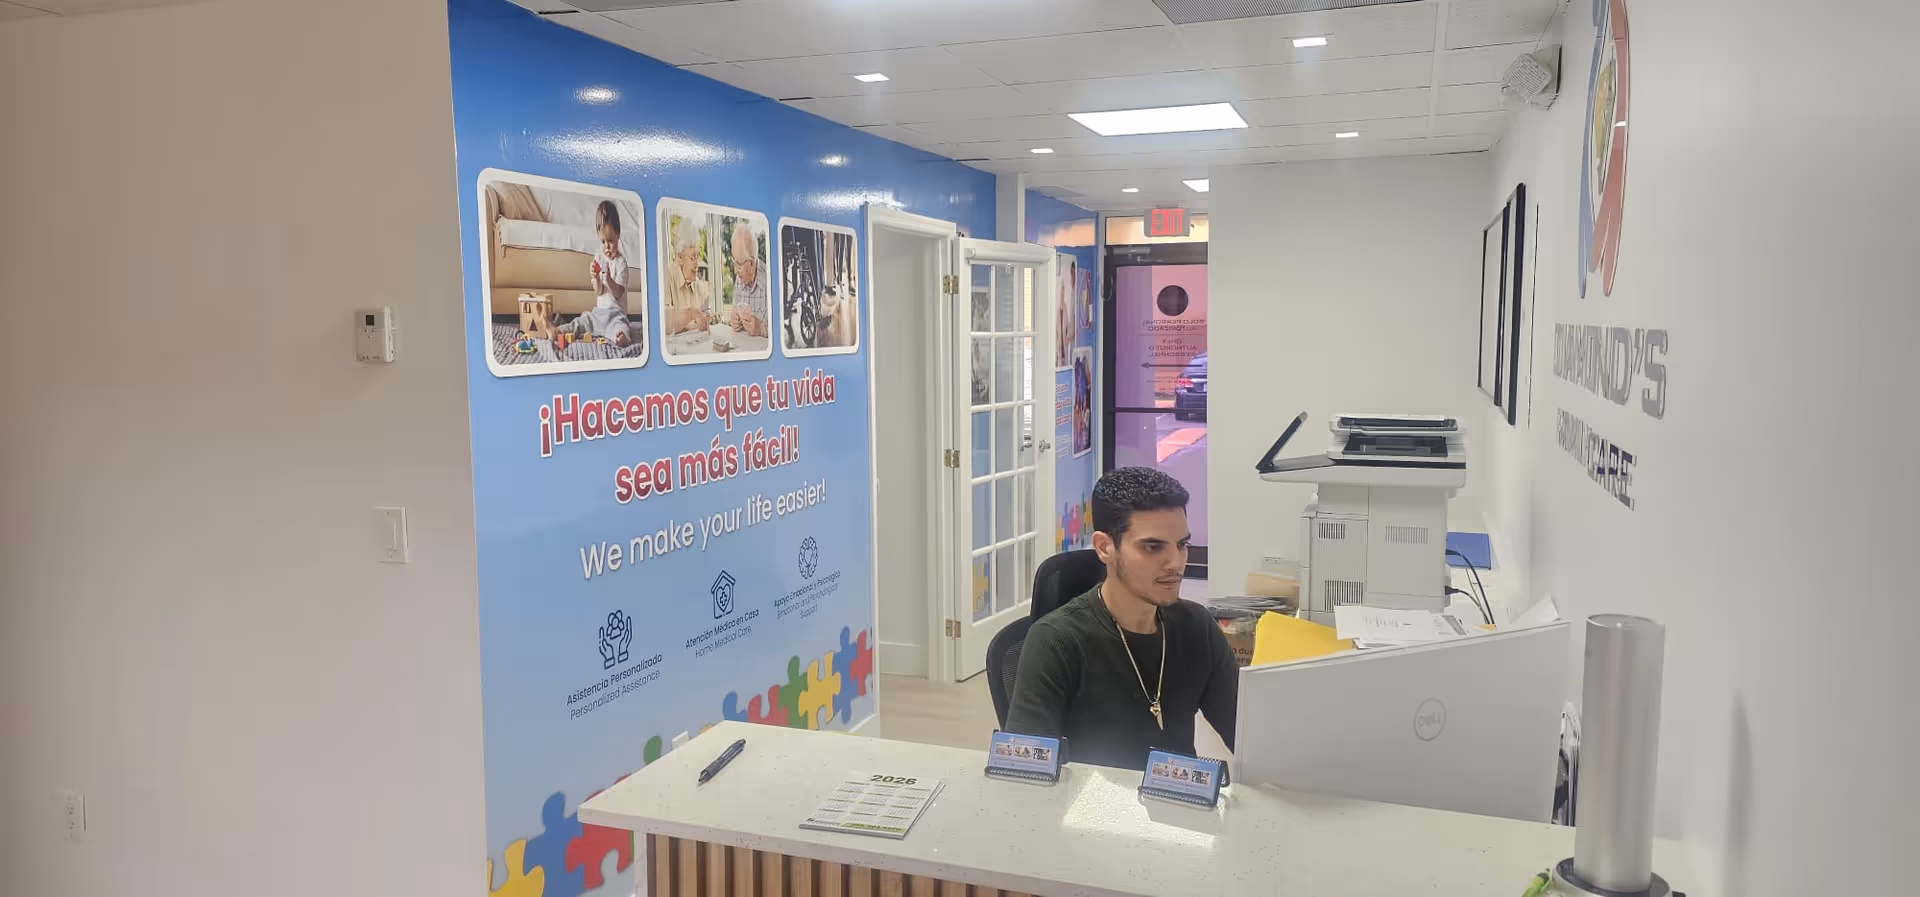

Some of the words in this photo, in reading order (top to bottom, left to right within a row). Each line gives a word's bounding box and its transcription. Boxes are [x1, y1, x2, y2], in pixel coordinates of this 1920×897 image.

[539, 388, 709, 458] ¡Hacemos
[714, 383, 762, 431] que
[766, 375, 789, 411] tu
[792, 367, 835, 408] vida
[615, 458, 673, 504] sea
[679, 434, 738, 489] más
[742, 424, 799, 473] fácil!
[1587, 432, 1637, 511] CARE
[580, 541, 622, 579] We
[629, 520, 694, 565] make
[699, 507, 743, 551] your
[746, 495, 772, 526] life
[776, 478, 826, 516] easier!
[696, 643, 713, 658] Home
[714, 631, 737, 649] Medical
[738, 625, 751, 638] Care
[736, 616, 744, 625] en
[744, 609, 759, 621] Casa
[567, 677, 608, 706] Asistencia
[611, 654, 663, 685] Personalizada
[570, 687, 620, 720] Personalized
[622, 670, 660, 695] Assistance
[870, 774, 917, 785] 2026
